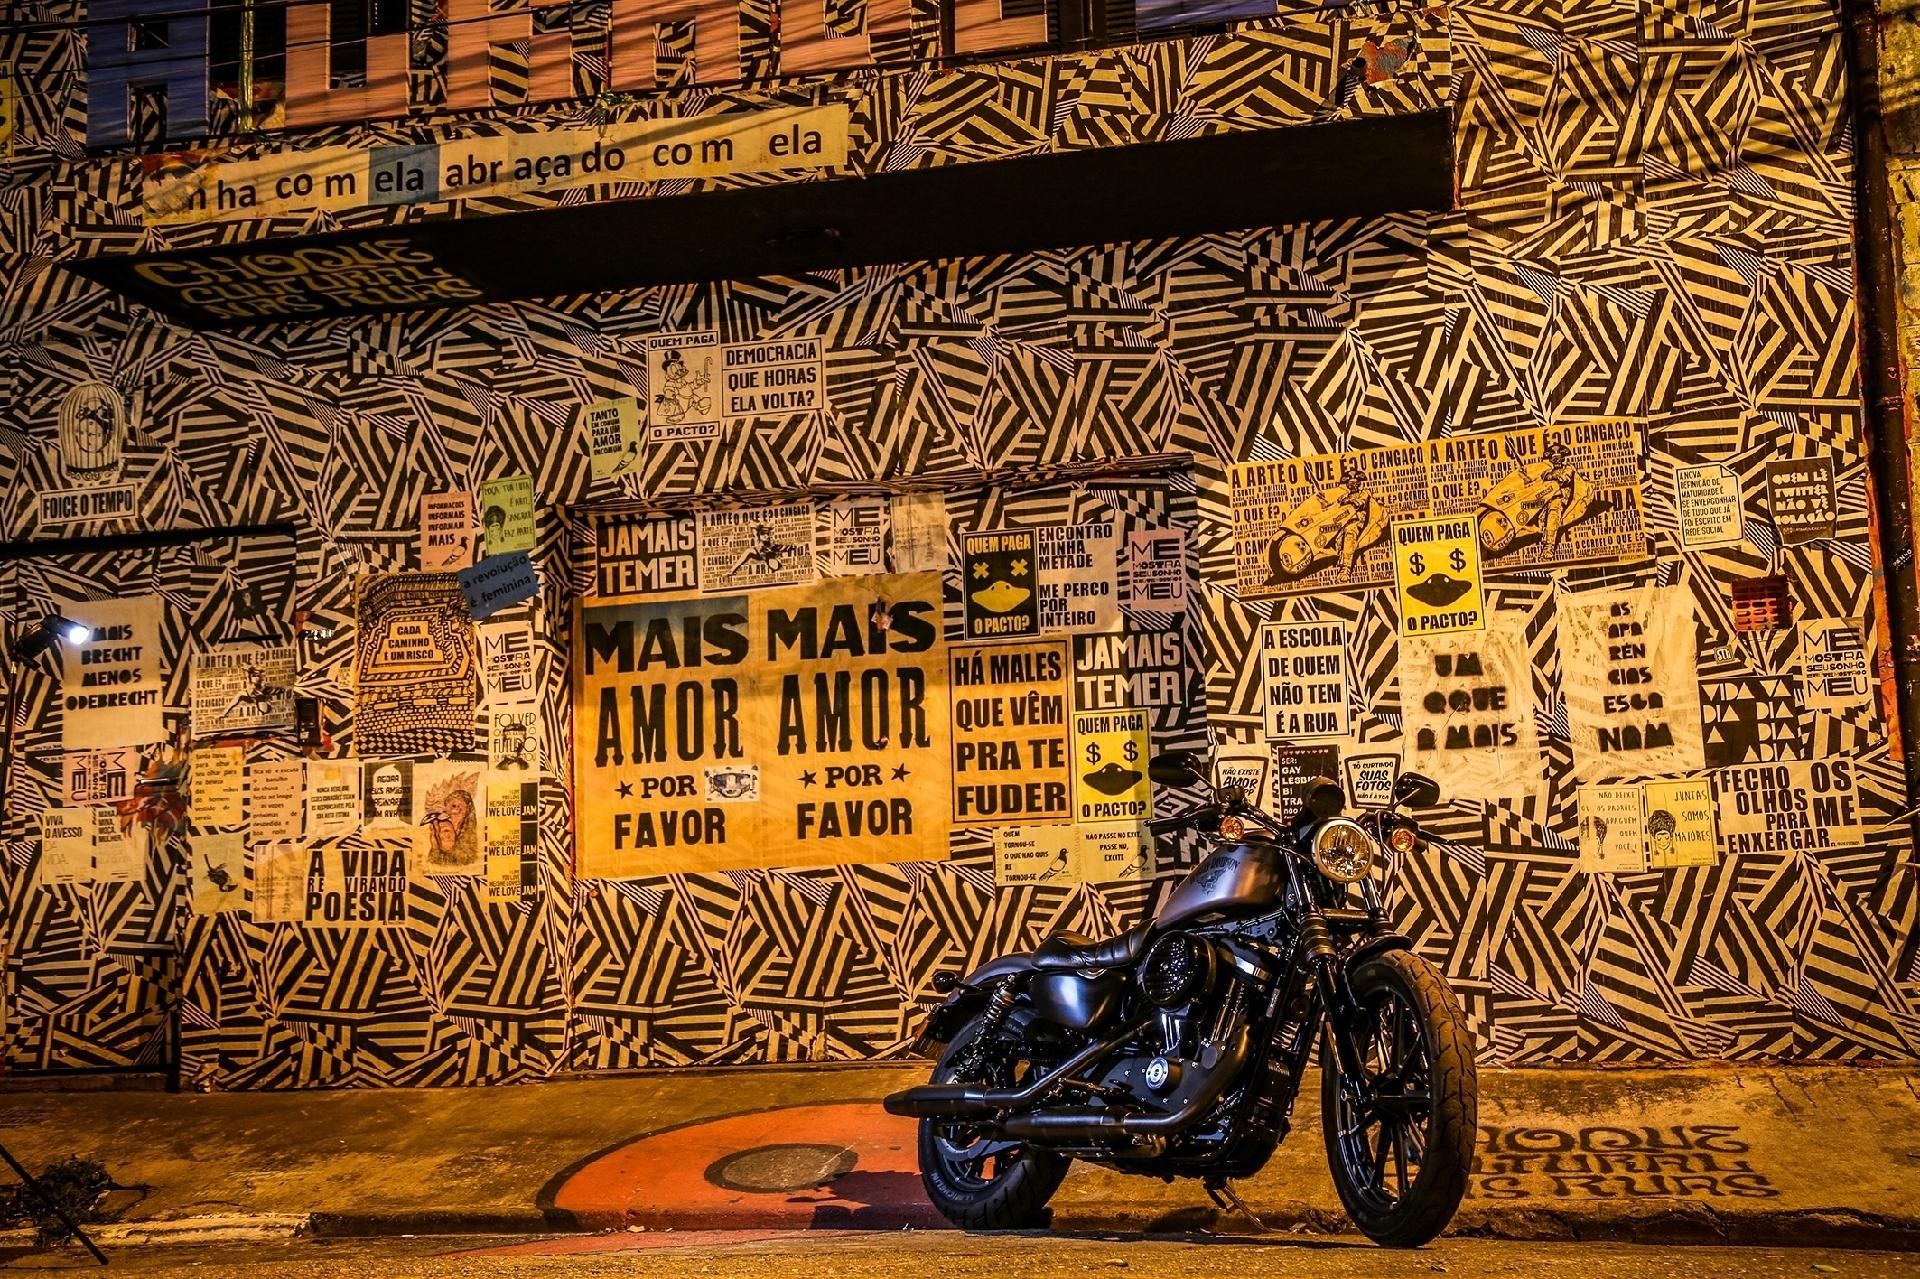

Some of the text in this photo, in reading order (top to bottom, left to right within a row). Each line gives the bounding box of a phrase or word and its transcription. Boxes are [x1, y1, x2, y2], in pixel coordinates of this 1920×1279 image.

[374, 161, 424, 193] ela
[768, 123, 822, 157] ela
[650, 334, 716, 350] QUEM PAGA
[726, 343, 817, 367] DEMOCRACIA
[728, 367, 817, 391] QUE HORAS
[731, 391, 815, 413] ELA VOLTA?
[590, 408, 618, 421] TANTO
[592, 427, 609, 436] PARA
[593, 434, 621, 448] AMOR
[667, 425, 715, 437] PACTO?
[1445, 421, 1631, 463] ARTE CANGAÇO
[1246, 446, 1424, 486] ARTE CANGAÇO
[1772, 472, 1809, 485] QUEM
[1443, 483, 1464, 499] QUE
[43, 490, 133, 519] FOICE O TEMPO
[1775, 498, 1806, 511] NÃO
[834, 506, 881, 527] ME
[1243, 507, 1264, 523] QUE
[428, 534, 455, 546] MAIS
[601, 518, 695, 559] JAMAIS
[834, 527, 881, 536] MOSTRA
[1039, 524, 1113, 542] ENCONTRO
[1398, 522, 1471, 546] QUEM PAGA
[1685, 525, 1723, 536] REDE SOCIAL
[966, 534, 1031, 553] QUEM PAGA
[1039, 540, 1086, 556] MINHA
[1131, 538, 1181, 561] ME
[834, 548, 881, 566] MEU
[1039, 554, 1093, 570] METADE
[1132, 560, 1182, 569] MOSTRA
[473, 555, 528, 584] revolução
[600, 555, 696, 594] TEMER
[481, 575, 532, 602] feminina
[1040, 581, 1110, 599] ME PERCO
[1132, 582, 1183, 601] MEU
[1040, 599, 1067, 613] POR
[985, 616, 1031, 633] PACTO?
[1040, 611, 1096, 628] INTEIRO
[1420, 610, 1478, 630] PACTO?
[397, 626, 421, 636] CADA
[767, 601, 937, 662] MAIS
[1264, 627, 1343, 650] A ESCOLA
[1608, 622, 1644, 639] APA
[1804, 627, 1865, 653] ME
[388, 638, 430, 648] CAMINHO
[485, 630, 531, 656] ME
[585, 613, 749, 676] MAIS
[1077, 632, 1181, 671] JAMAIS
[81, 646, 143, 665] BRECHT
[406, 649, 434, 660] RISCO
[1805, 651, 1865, 663] MOSTRA
[955, 649, 1062, 687] HÁ MALES
[1268, 655, 1340, 678] DE QUEM
[1434, 652, 1484, 678] UM
[1806, 661, 1866, 673] SEU SONHO
[81, 668, 142, 687] MENOS
[487, 674, 532, 695] MEU
[1808, 676, 1869, 698] MEU
[65, 690, 158, 711] ODEBRECHT
[1077, 671, 1183, 710] TEMER
[1270, 681, 1342, 706] NÃO TEM
[1701, 682, 1755, 702] VIDA
[777, 666, 931, 756] AMOR
[955, 691, 1063, 732] QUE VÊM
[1703, 701, 1794, 724] DIA DIA
[594, 677, 744, 769] AMOR
[1077, 714, 1144, 734] QUEM PAGA
[1289, 712, 1339, 734] A RUA
[1757, 722, 1796, 742] DIA
[1445, 723, 1518, 750] MAIS
[1598, 722, 1675, 752] NAM
[957, 738, 1065, 771] PRA TE
[825, 764, 884, 789] POR
[1282, 766, 1302, 775] GAY
[1282, 775, 1322, 785] LÉSBIC
[1359, 770, 1389, 781] SUAS
[1721, 760, 1851, 793] FECHO OS
[641, 775, 698, 799] POR
[1356, 780, 1392, 791] FOTOS
[958, 782, 1067, 816] FUDER
[1674, 790, 1708, 802] JUNTAS
[1736, 789, 1808, 816] OLHOS
[502, 805, 537, 816] LOVE JAM
[797, 798, 913, 840] FAVOR
[1094, 801, 1147, 817] PACTO?
[1681, 810, 1709, 822] SOMOS
[1766, 795, 1859, 831] PARA ME
[46, 815, 63, 826] VIVA
[614, 808, 726, 850] FAVOR
[52, 827, 83, 839] AVESSO
[1674, 831, 1711, 842] MAIORES
[1727, 829, 1831, 854] ENXERGAR
[502, 845, 537, 856] LOVE JAM
[308, 850, 407, 877] A VIDA
[345, 877, 407, 892] VIRANDO
[1005, 874, 1037, 882] TORNOU-SE
[502, 885, 537, 896] LOVE JAM
[305, 892, 406, 921] POESIA
[1476, 1125, 1749, 1154] HOQUE
